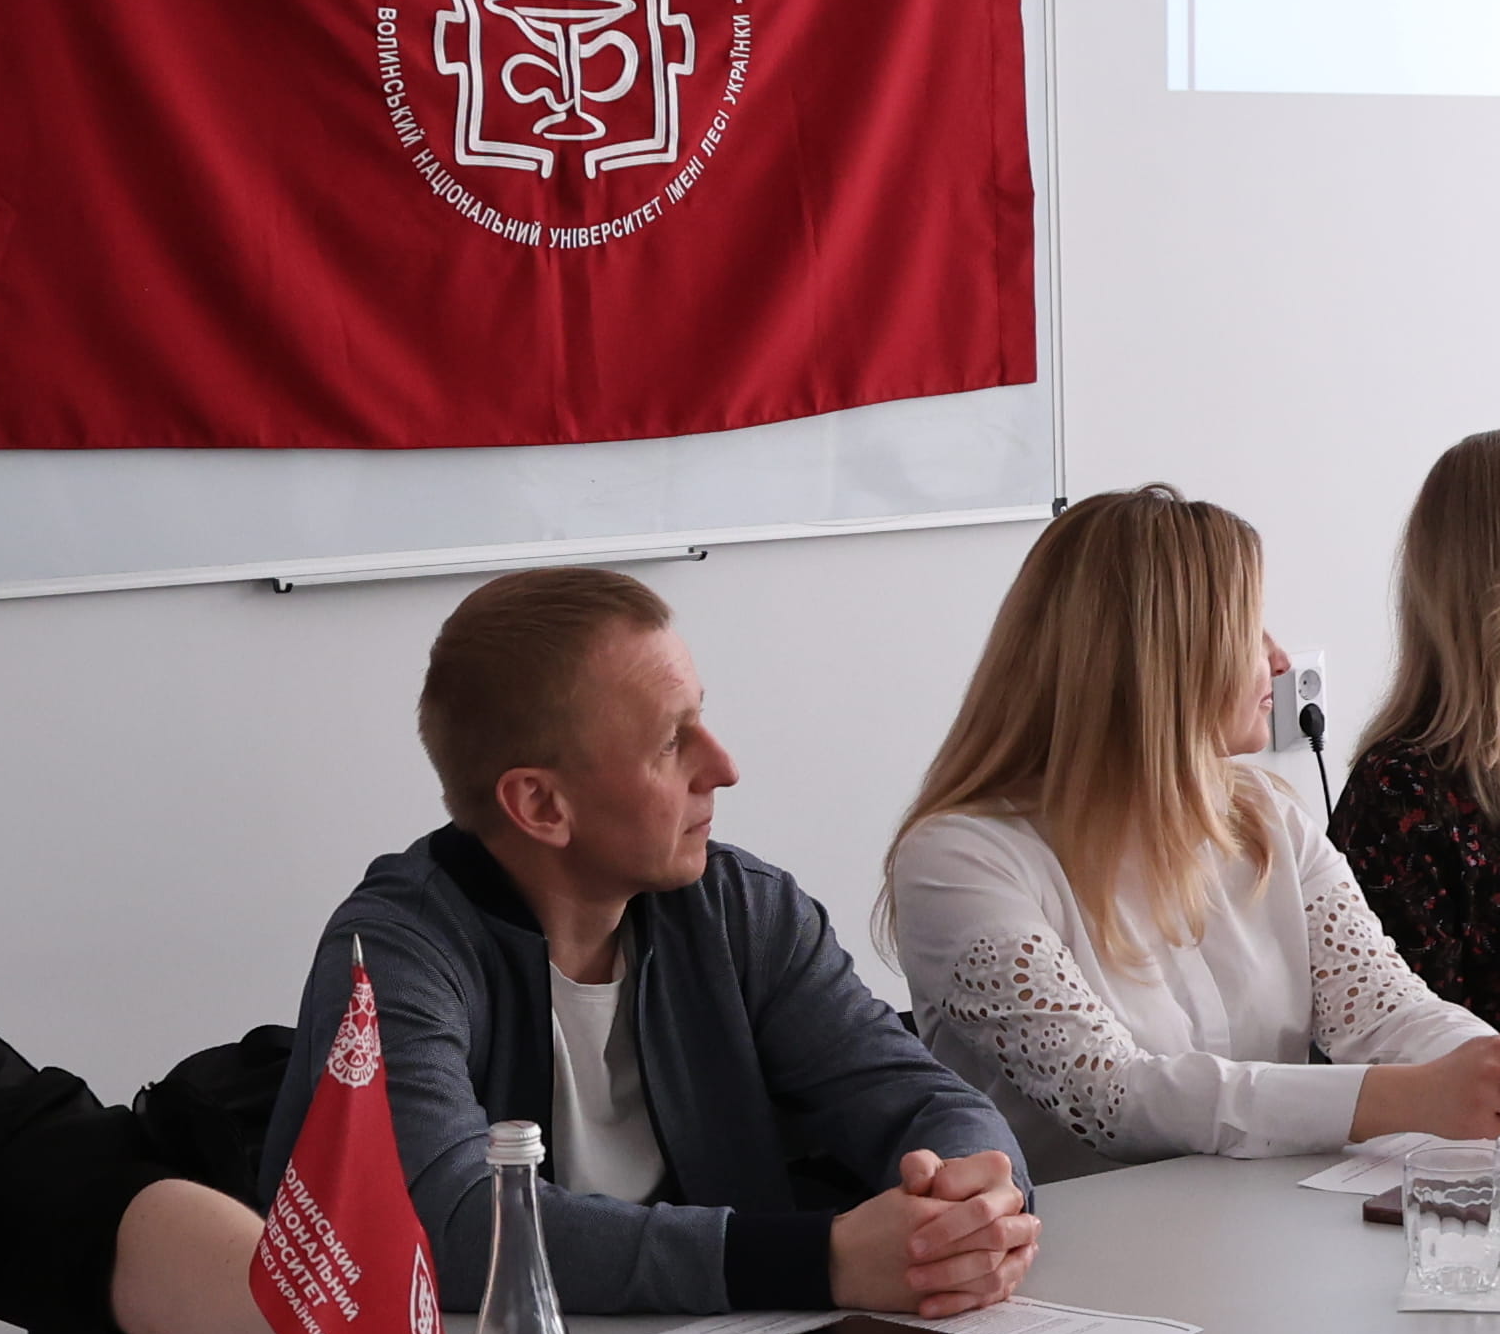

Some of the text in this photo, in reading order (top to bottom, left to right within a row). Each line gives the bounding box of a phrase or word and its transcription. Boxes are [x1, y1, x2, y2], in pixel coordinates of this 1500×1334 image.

[377, 7, 750, 249] ВОЛИНСЬКИЙ НАЦІОНАЛЬНИЙ УНІВЕРСИТЕТ ІМЕНІ ЛЕСІ УКРАЇНКИ
